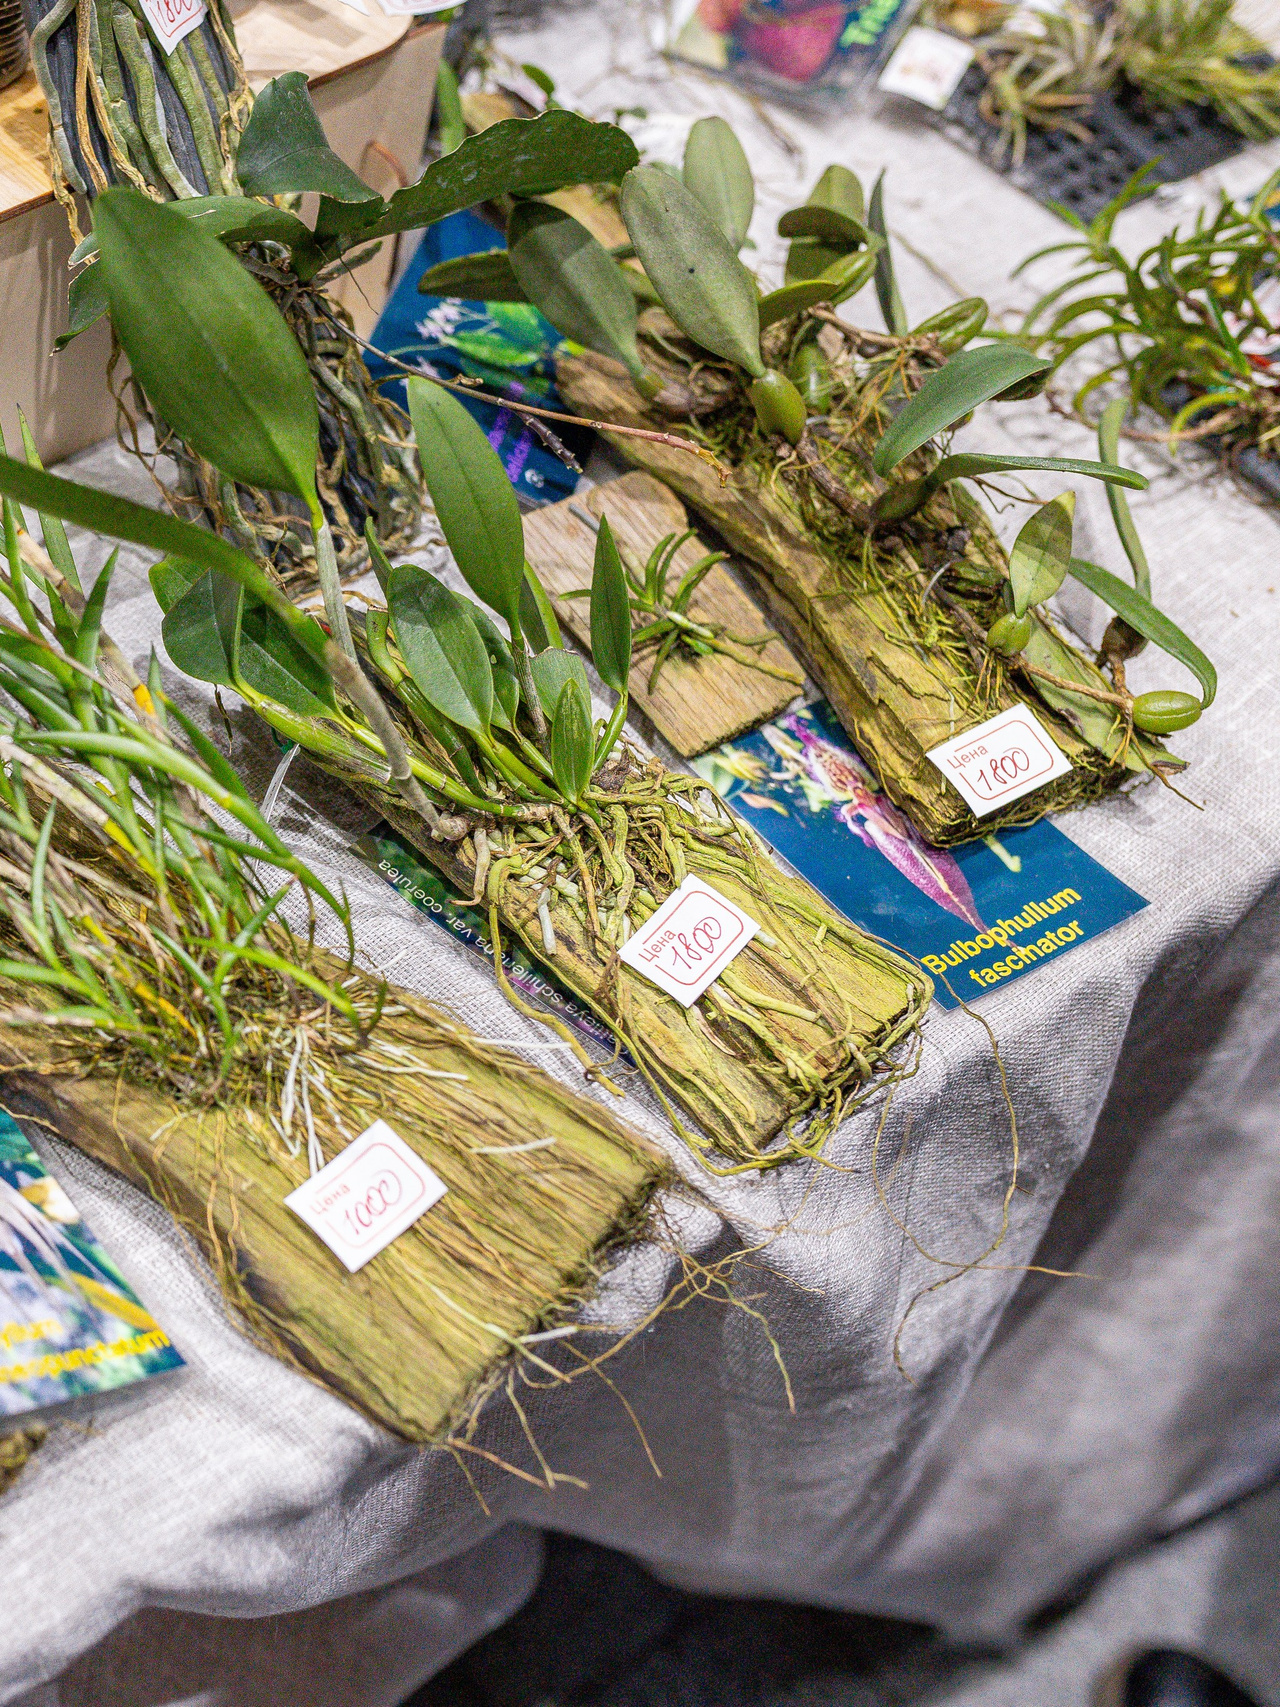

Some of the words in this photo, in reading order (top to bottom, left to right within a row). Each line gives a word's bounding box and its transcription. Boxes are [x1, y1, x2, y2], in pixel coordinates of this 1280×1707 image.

[947, 744, 989, 769] Цена
[976, 746, 1030, 792] 1800
[378, 859, 443, 915] coerulea
[638, 929, 677, 963] Цена
[671, 916, 722, 970] 1800
[921, 887, 1082, 975] Bulbophullum
[968, 919, 1085, 988] fascinator
[309, 1184, 351, 1215] Цена
[343, 1169, 402, 1236] 1000
